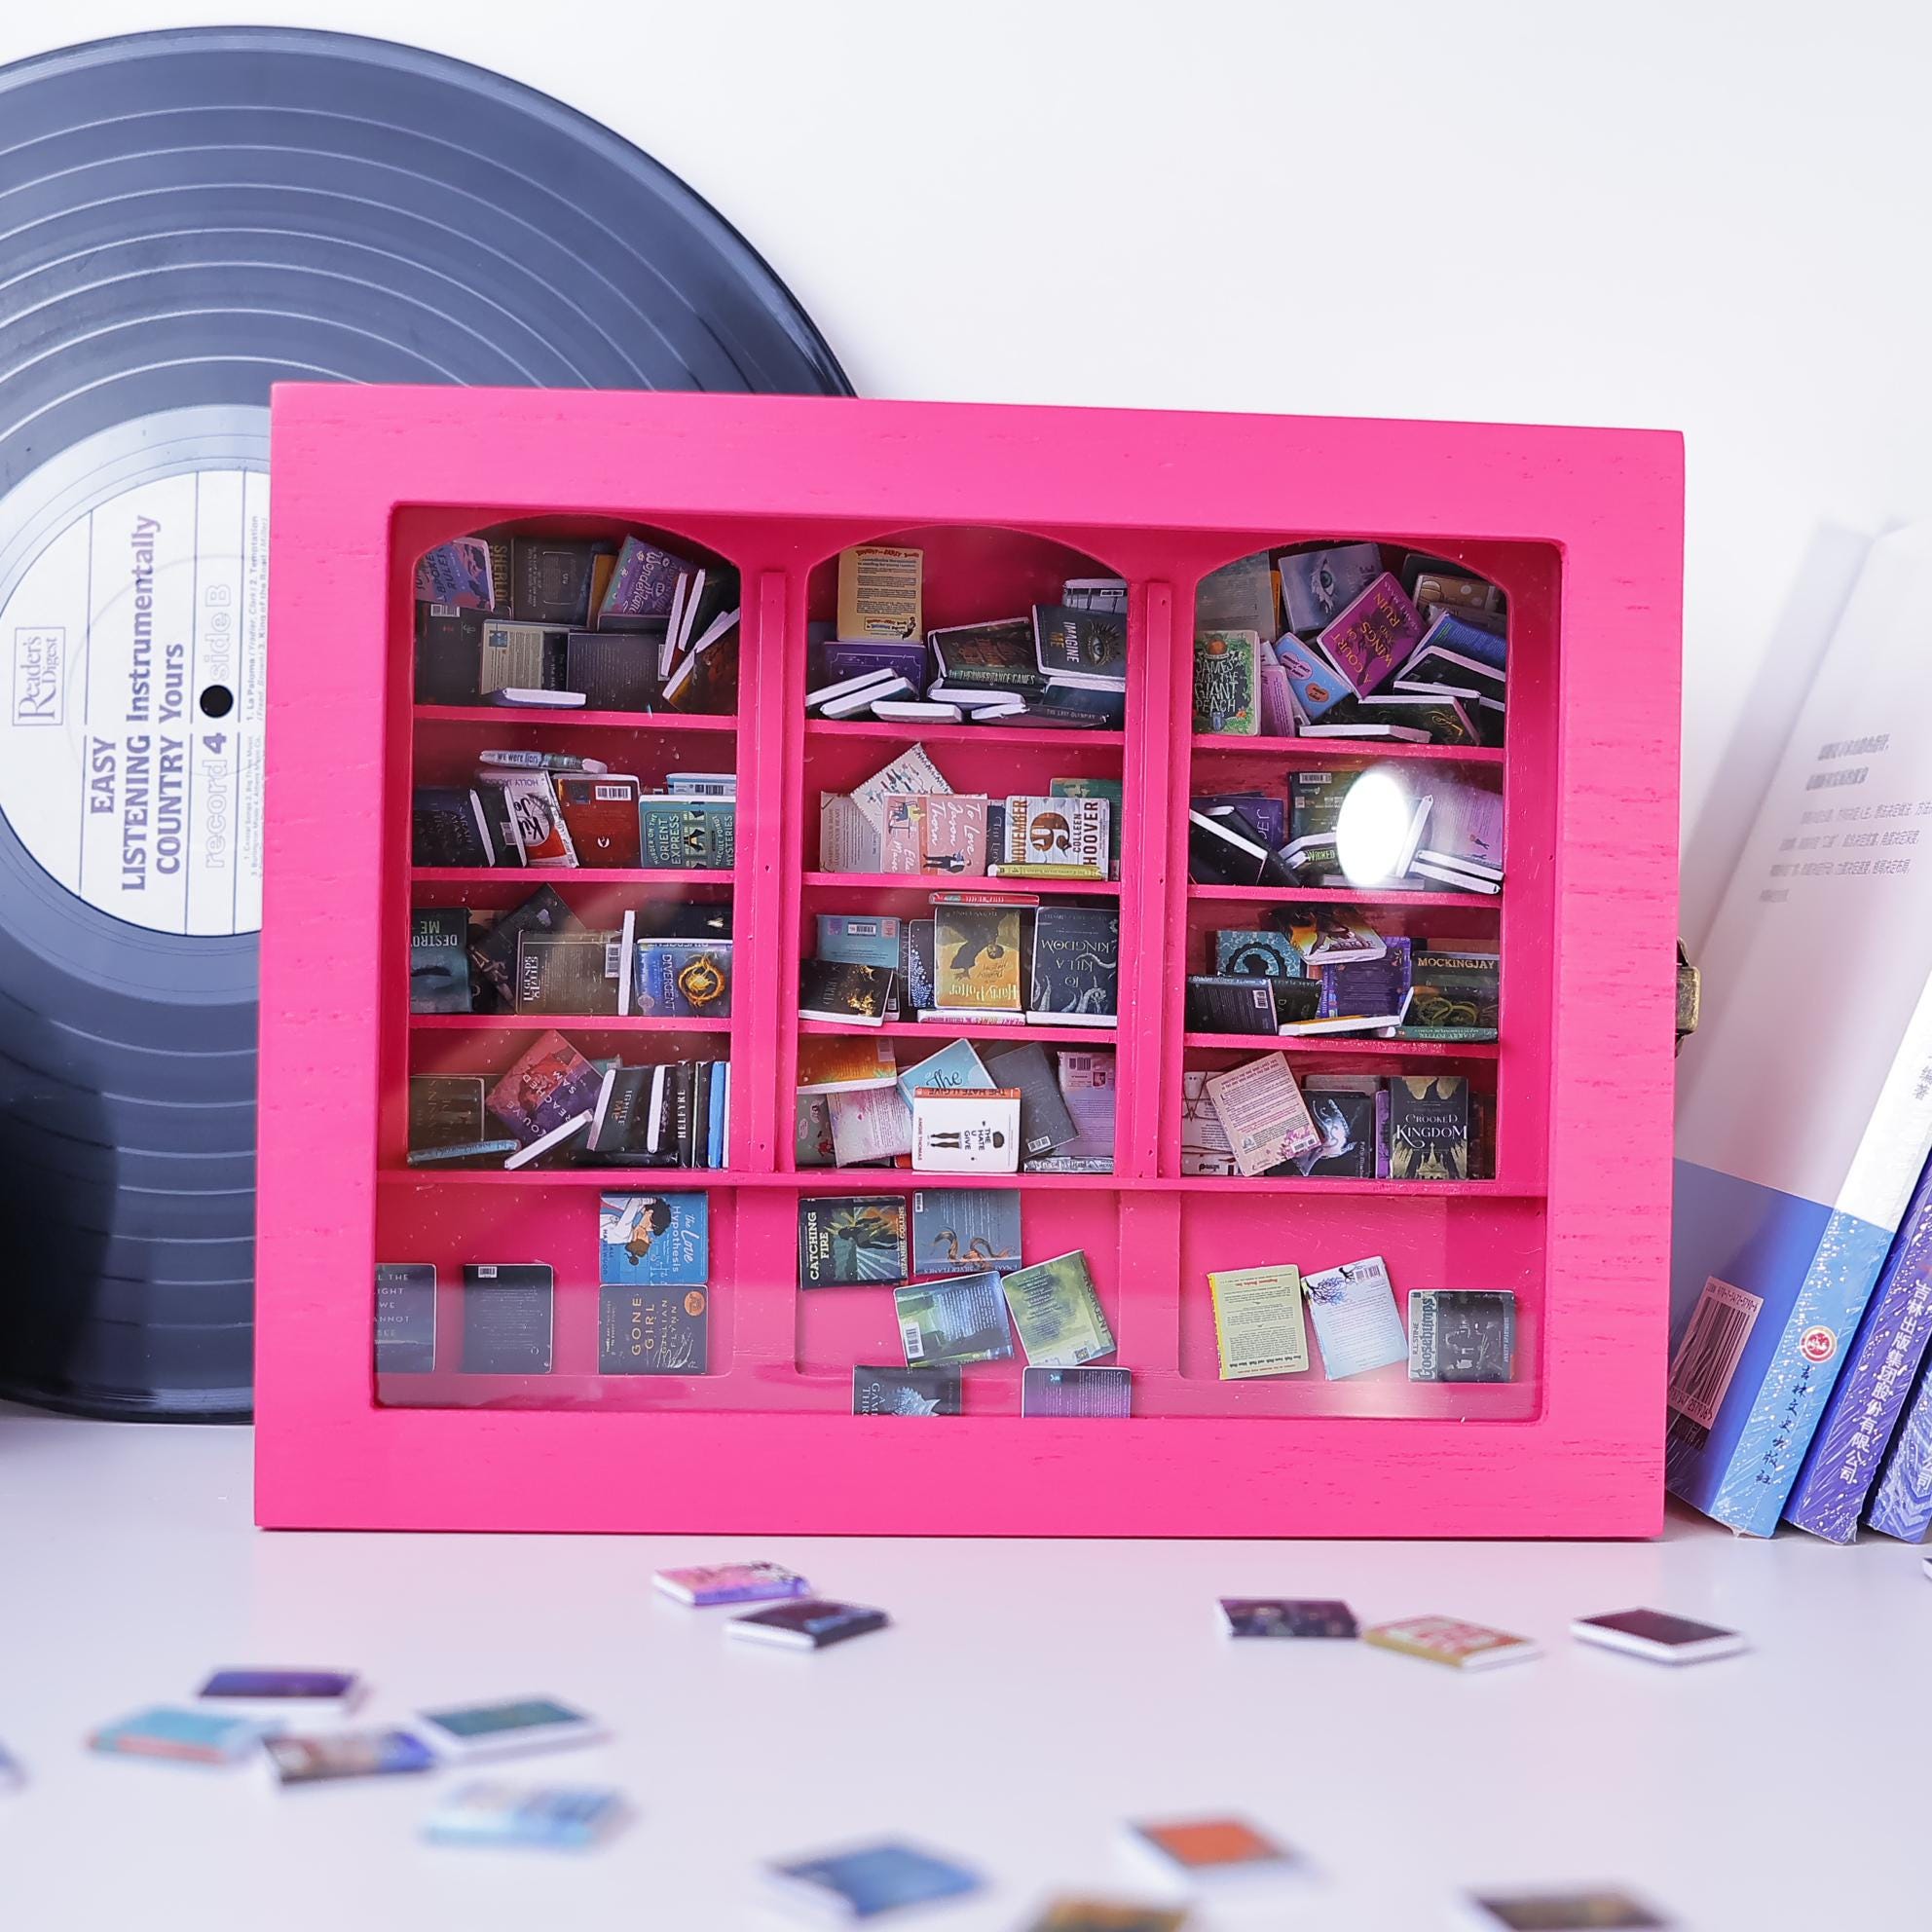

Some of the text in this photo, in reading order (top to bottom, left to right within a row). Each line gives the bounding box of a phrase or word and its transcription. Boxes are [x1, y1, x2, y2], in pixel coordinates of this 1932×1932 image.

[250, 515, 259, 573] Temptation
[126, 514, 161, 723] Instrumentally
[1373, 592, 1400, 628] RUIN
[204, 584, 231, 683] side B
[1051, 632, 1065, 649] ME
[1063, 621, 1080, 663] IMAGINE
[1331, 633, 1363, 673] COURT
[1362, 621, 1393, 669] WINGS
[18, 635, 56, 719] Reader's
[41, 636, 58, 684] Digest
[247, 656, 256, 695] Paloma
[1012, 674, 1036, 686] GAMES
[1196, 660, 1233, 674] JAMES
[1220, 672, 1238, 682] THE
[159, 643, 184, 724] Yours
[1195, 681, 1239, 700] GIANT
[1196, 697, 1236, 716] PEACH
[91, 737, 117, 814] EASY
[508, 753, 523, 762] were
[122, 735, 151, 891] LISTENING
[156, 736, 184, 875] COUNTRY
[204, 731, 227, 869] record 4
[659, 818, 670, 861] ORIENT
[669, 813, 681, 865] EXPRESS
[724, 815, 734, 866] MYSTERIES
[930, 801, 947, 847] Thorn
[947, 801, 964, 847] Jason
[963, 803, 983, 855] To Love
[1029, 812, 1071, 853] 9
[1072, 813, 1082, 853] COLLEEN
[1083, 801, 1099, 865] HOOVER
[891, 839, 904, 873] Maise
[904, 848, 916, 873] Ella
[1308, 850, 1335, 862] WICKED
[411, 934, 458, 947] DESTRO
[420, 920, 440, 934] ME
[1041, 939, 1111, 955] KINGDOM
[662, 954, 675, 1010] DIVERGENT
[1064, 976, 1080, 988] TO
[1067, 959, 1093, 974] KILL
[1418, 957, 1496, 969] MOCKINGJAY
[947, 983, 1019, 1003] Harry Potter
[522, 1073, 572, 1122] REACHED
[552, 1070, 576, 1095] SAM
[926, 1068, 963, 1089] The
[618, 1090, 632, 1126] IGNITE
[1405, 1113, 1459, 1124] CROOKED
[1396, 1124, 1468, 1149] KINGDOM
[671, 1206, 683, 1273] Hypothesis
[681, 1213, 700, 1264] the Love
[807, 1211, 821, 1281] CATCHING
[819, 1232, 830, 1260] FIRE
[900, 1239, 909, 1277] SUZANNE
[374, 1287, 405, 1296] IGHT
[631, 1297, 643, 1356] GONE
[645, 1303, 656, 1350] GIRL
[670, 1305, 679, 1349] FLYNN
[1418, 1296, 1436, 1379] Goosebumps
[1839, 1279, 1932, 1485] 吉林出版集团股份有限公司
